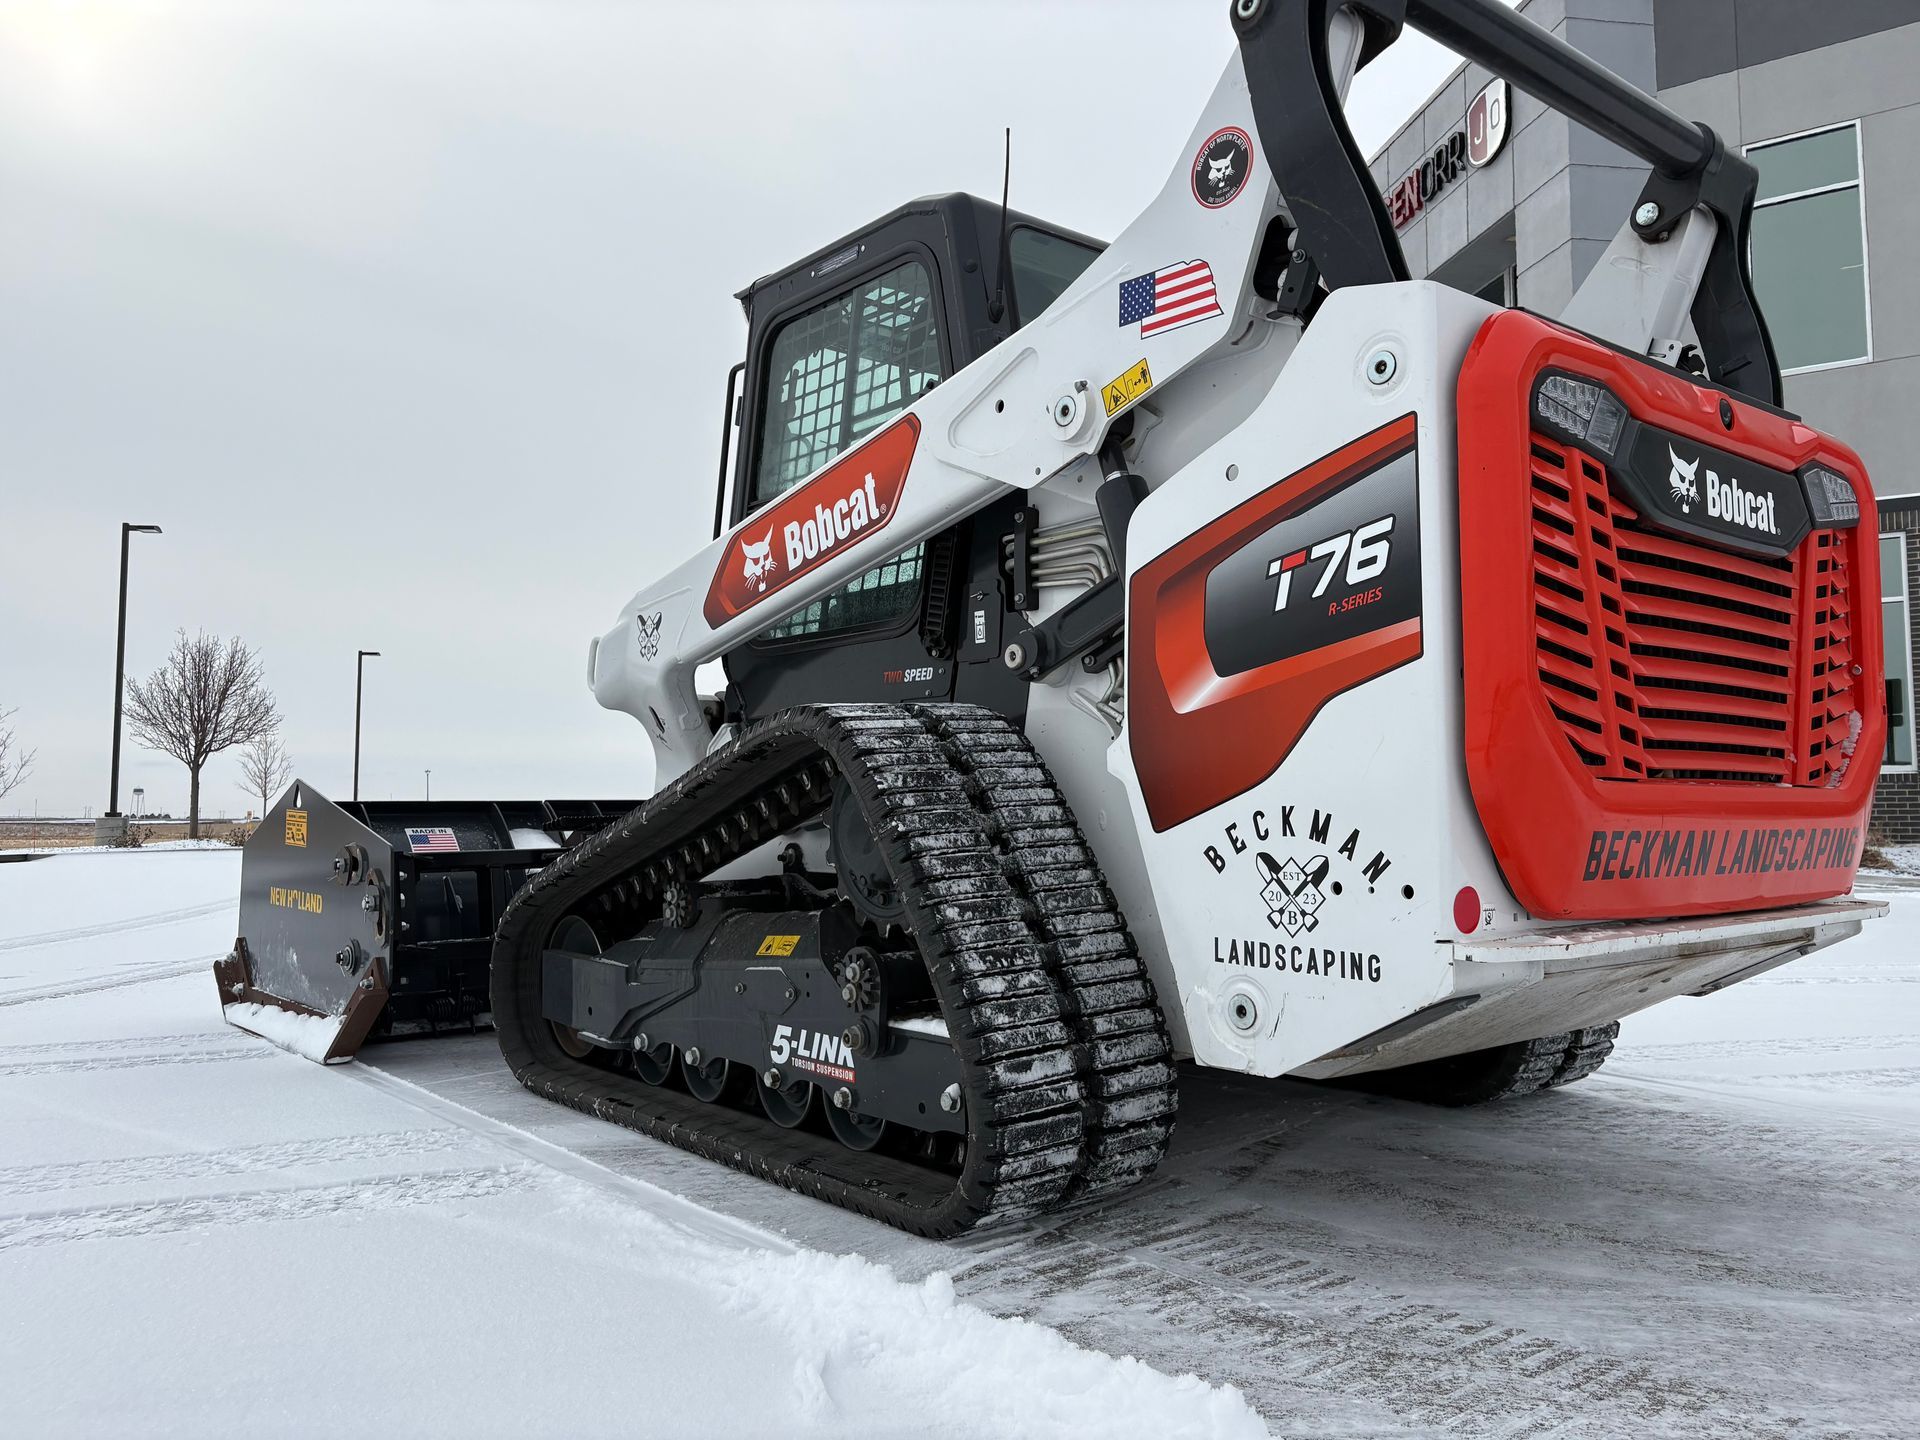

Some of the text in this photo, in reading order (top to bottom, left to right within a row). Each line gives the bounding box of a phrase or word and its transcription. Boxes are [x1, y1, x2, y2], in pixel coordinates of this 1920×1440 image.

[1209, 140, 1216, 149] OF
[1216, 133, 1233, 144] NORTH
[1232, 134, 1248, 152] PLATTE
[1705, 469, 1777, 535] Bobcat
[783, 472, 880, 572] Bobcat
[1267, 515, 1395, 613] T76
[1328, 586, 1383, 617] R-SERIES
[883, 667, 934, 684] TWO SPEED
[1203, 805, 1392, 885] BECKMAN
[1582, 827, 1859, 882] BECKMAN LANDSCAPING
[1282, 871, 1302, 882] EST
[270, 886, 323, 914] NEW HOLLAND
[1268, 890, 1317, 905] 20 23
[1287, 911, 1298, 925] B
[1214, 936, 1381, 983] LANDSCAPING
[770, 1024, 855, 1069] 5-LINK
[791, 1057, 854, 1081] TORSION SUSPENSION
